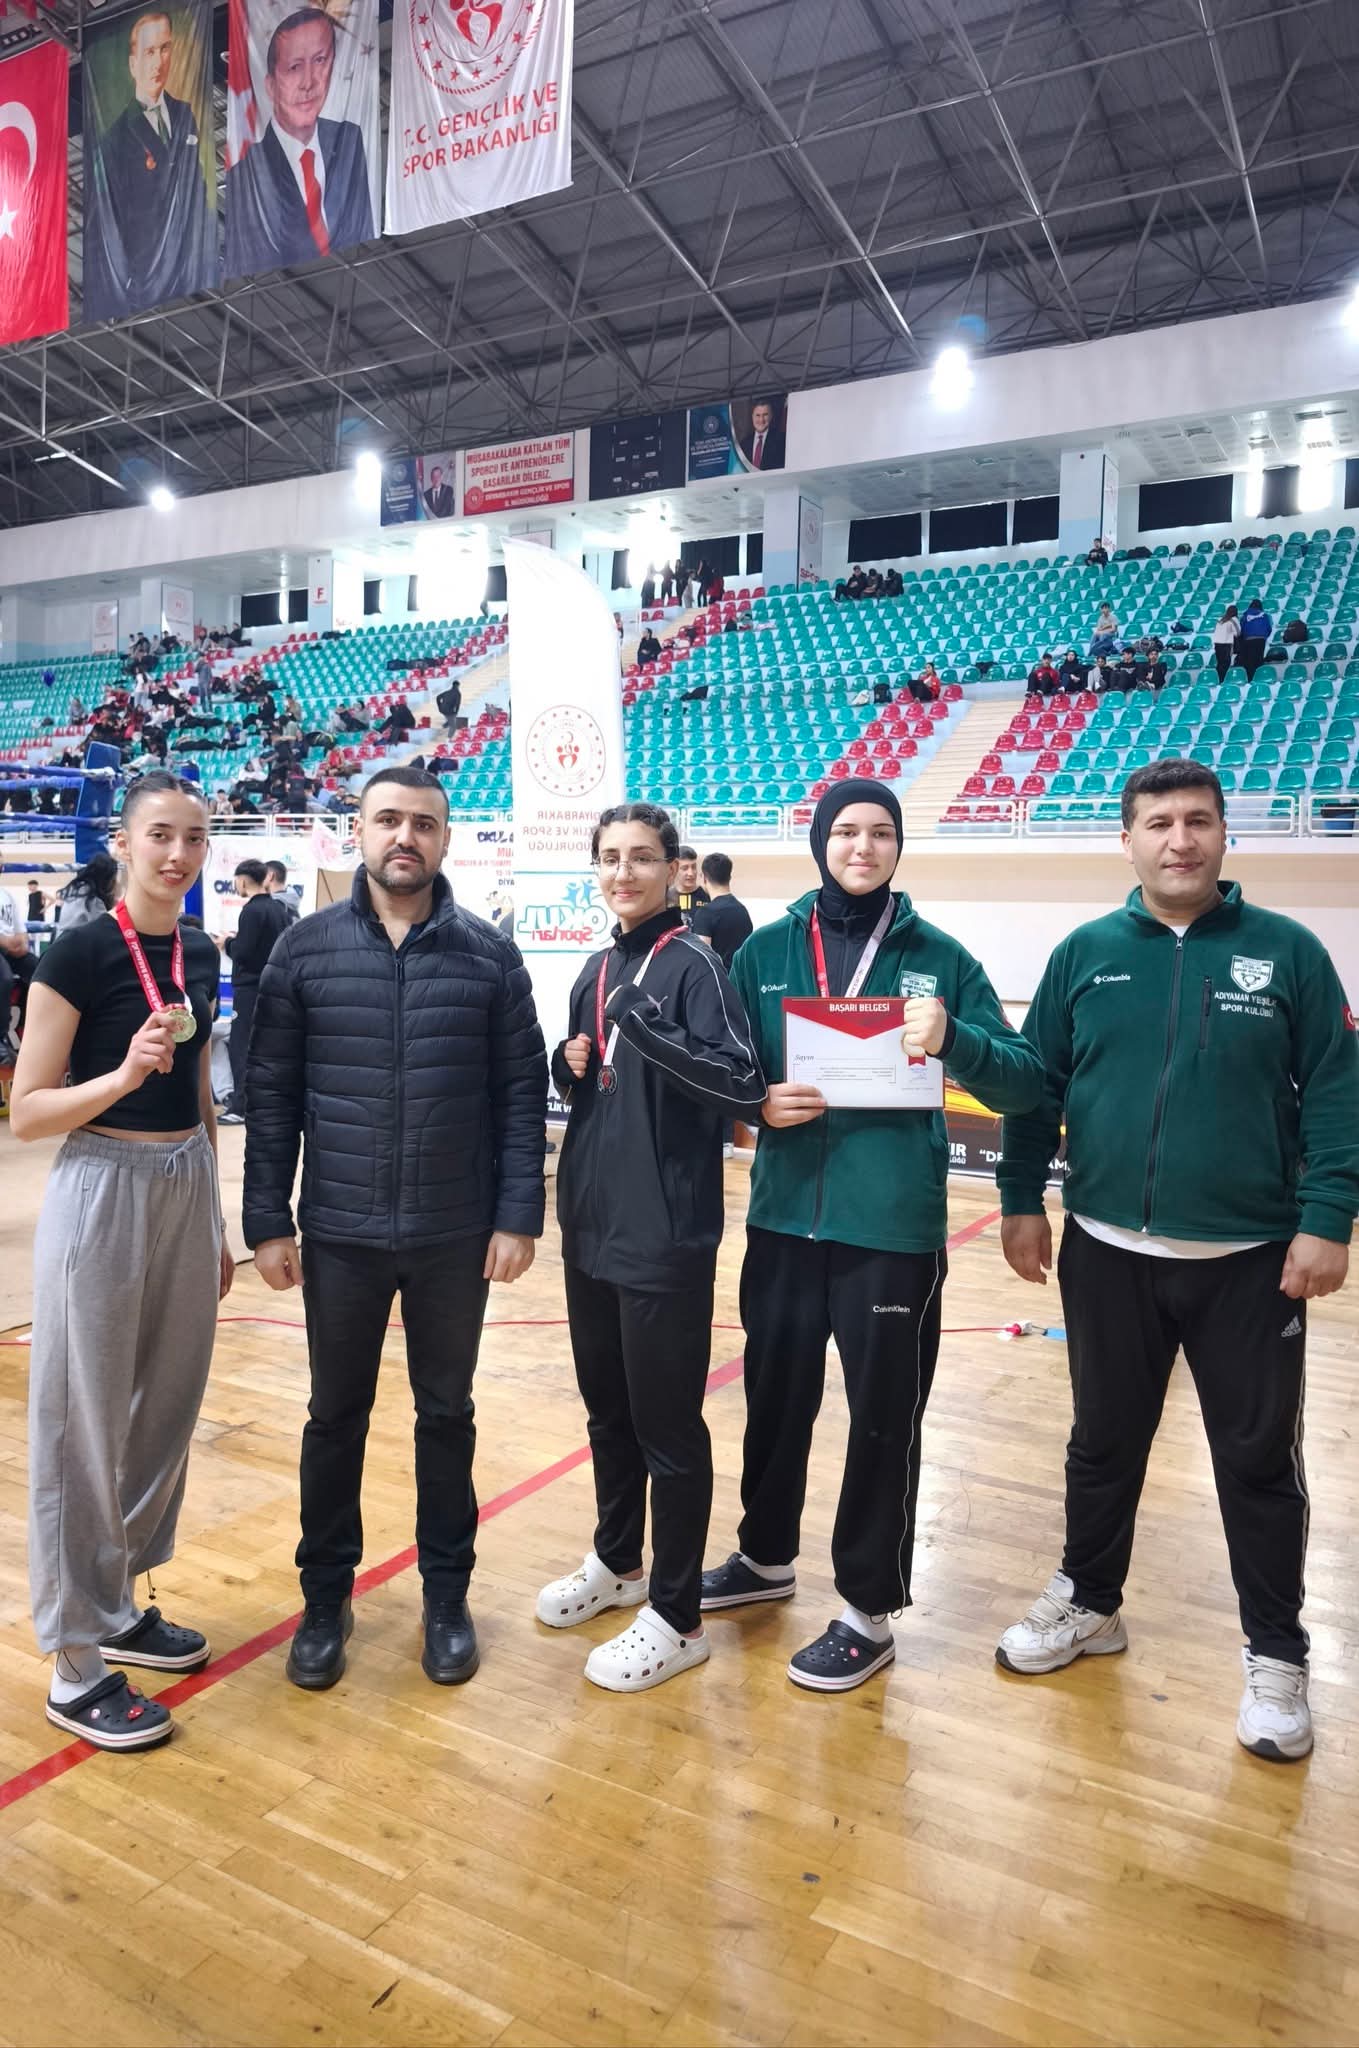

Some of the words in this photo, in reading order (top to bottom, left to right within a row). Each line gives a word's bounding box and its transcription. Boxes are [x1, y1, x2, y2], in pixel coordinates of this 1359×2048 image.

[404, 124, 432, 148] T.C.
[438, 92, 526, 137] GENÇLİK
[532, 82, 558, 108] VE
[403, 148, 447, 178] SPOR
[451, 110, 558, 162] BAKANLIĞI
[523, 441, 552, 454] KATILAN
[555, 438, 570, 449] TÜM
[471, 464, 498, 477] SPORCU
[501, 463, 509, 472] VE
[510, 453, 565, 470] ANTRENÖRLERE
[483, 475, 521, 488] BAŞARILAR
[317, 587, 324, 600] F
[497, 848, 513, 857] MU
[1102, 974, 1131, 983] Columbia
[1214, 992, 1250, 1003] ADIYAMAN
[829, 1003, 857, 1014] BAŞARI
[859, 1002, 890, 1012] BELGESİ
[1220, 1003, 1243, 1013] SPOR
[948, 1142, 967, 1157] IR
